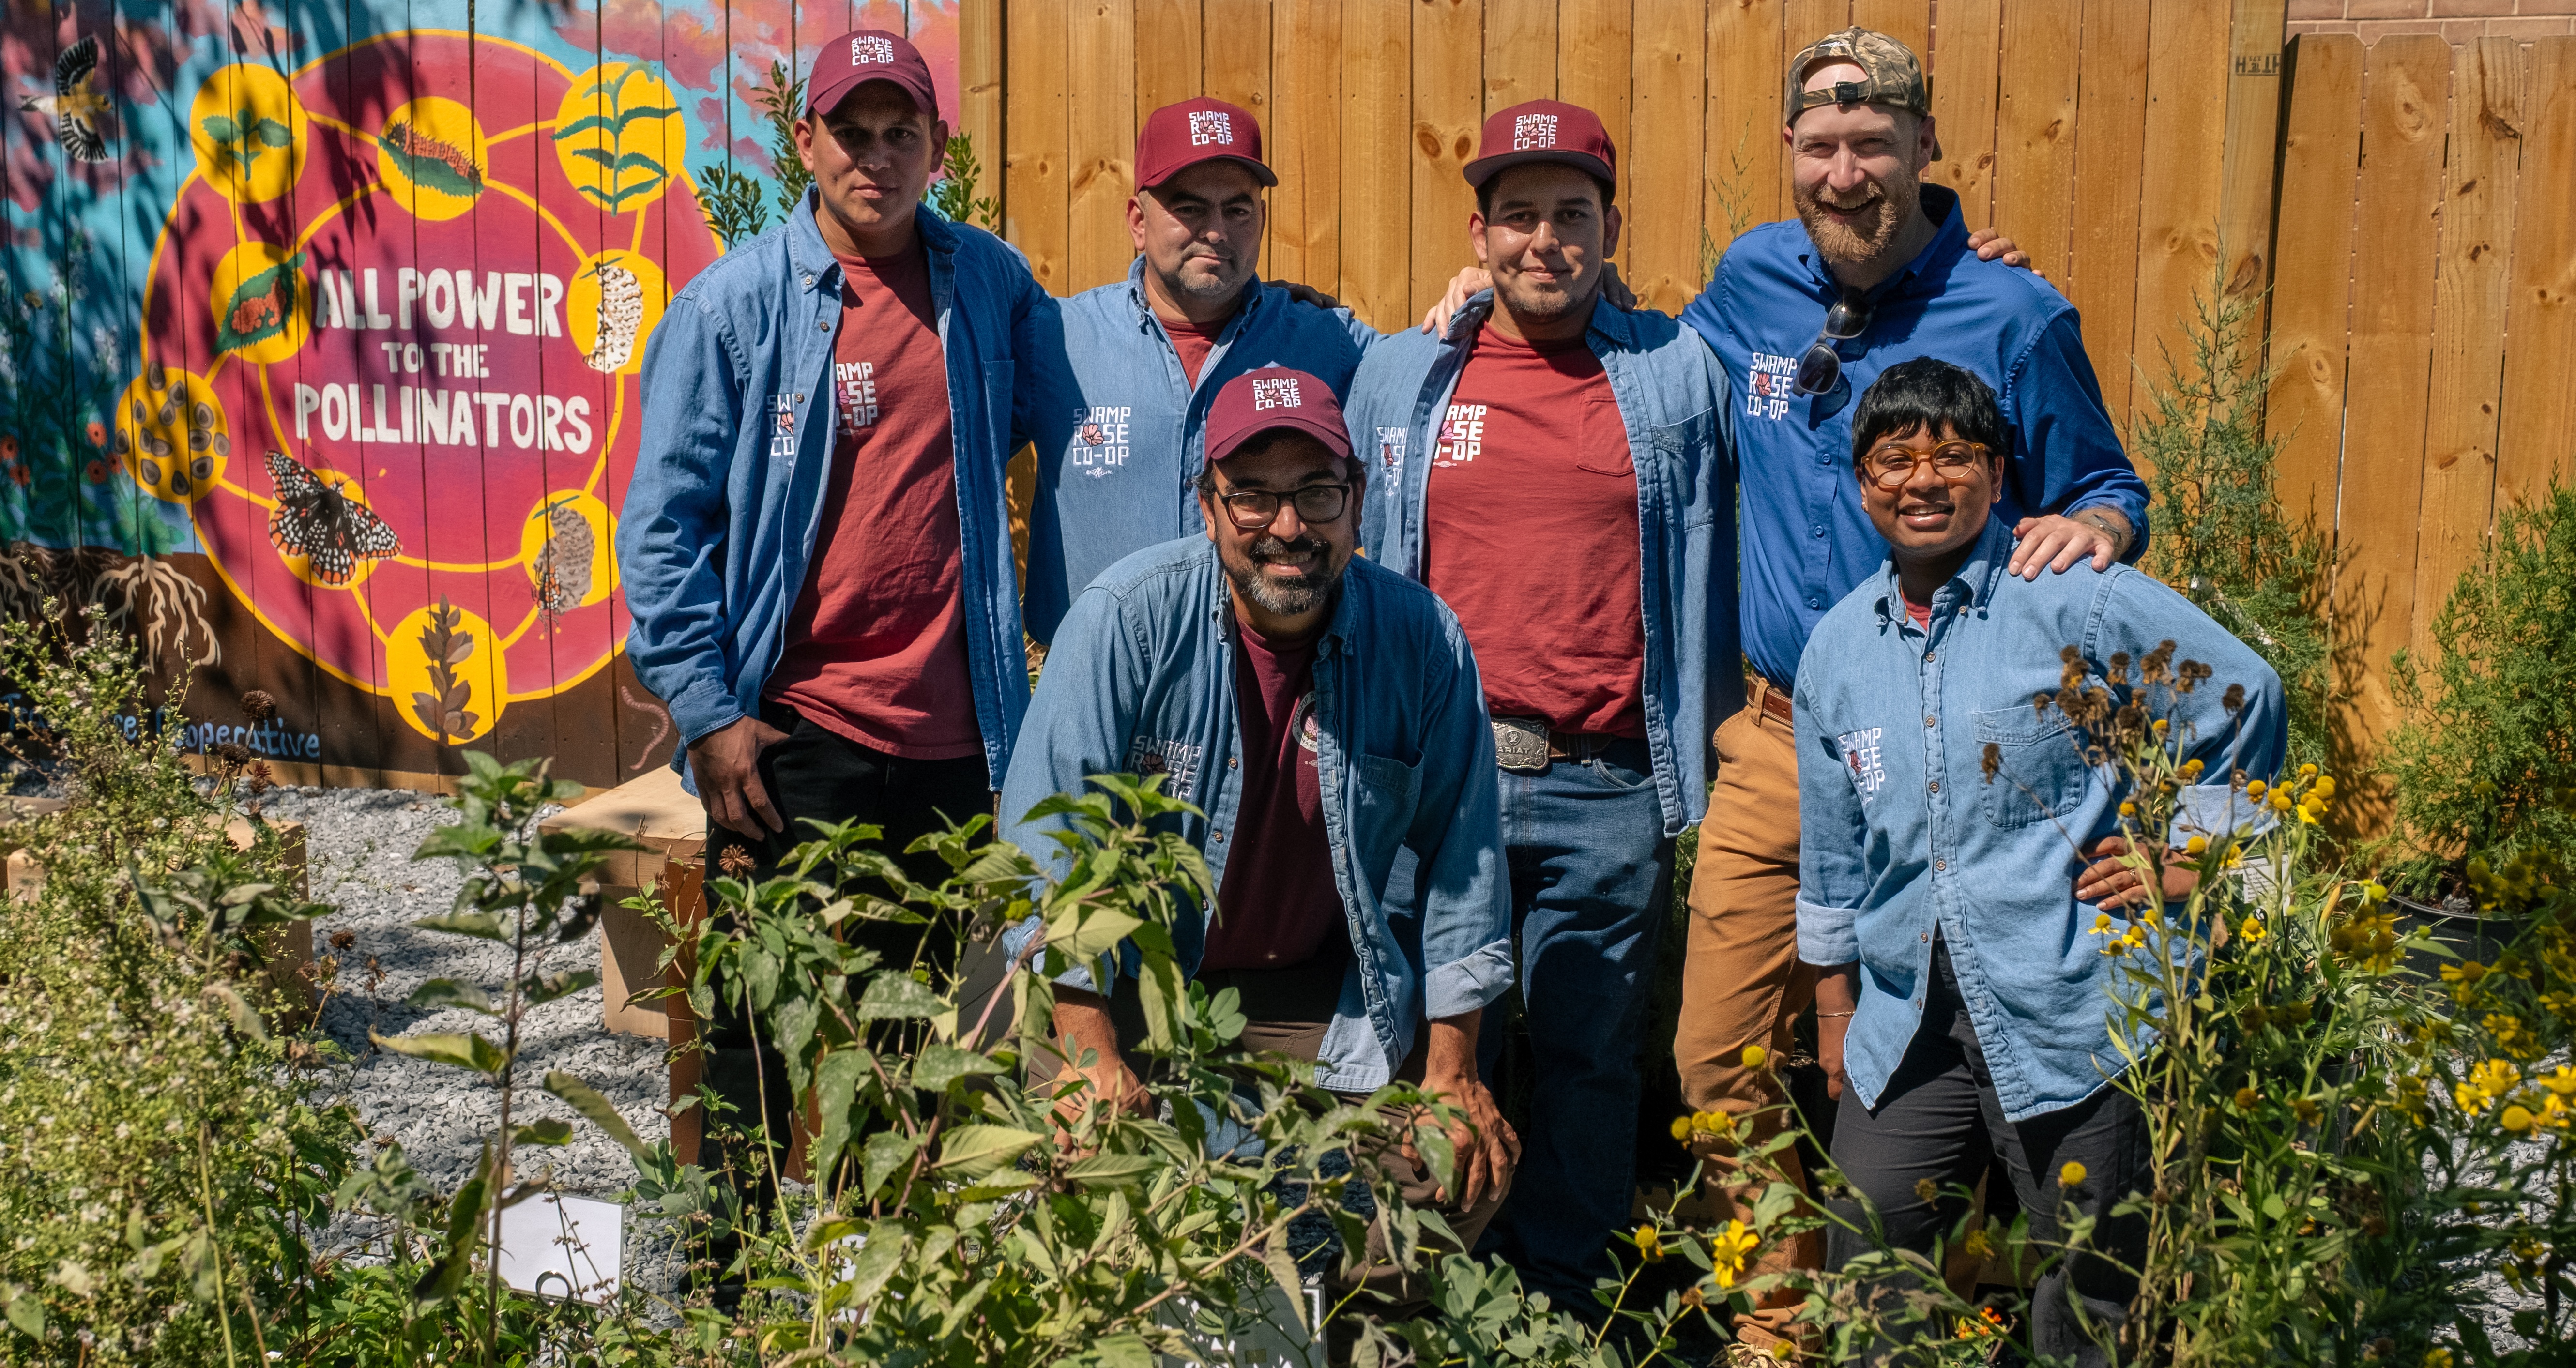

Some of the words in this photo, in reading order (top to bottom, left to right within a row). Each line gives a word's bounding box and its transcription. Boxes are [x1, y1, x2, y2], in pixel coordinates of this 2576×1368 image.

[851, 36, 892, 46] SWAMP
[852, 54, 894, 66] CO-OP
[1189, 111, 1229, 122] SWAMP
[1515, 114, 1558, 125] SWAMP
[1192, 133, 1233, 145] CO-OP
[1514, 137, 1555, 150] CO-OP
[316, 268, 392, 330] ALL
[398, 268, 564, 337] POWER
[382, 342, 424, 373] TO
[432, 343, 490, 378] THE
[1750, 352, 1797, 375] SWAMP
[836, 362, 873, 381] AMP
[1253, 378, 1298, 389] SWAMP
[1256, 398, 1301, 410] CO-OP
[1747, 395, 1789, 421] CO-OP
[294, 382, 593, 454] POLLINATORS
[1073, 406, 1130, 424] SWAMP
[1446, 405, 1487, 421] AMP
[1073, 446, 1129, 465] CO-OP
[1133, 736, 1202, 762] SWAMP
[1497, 746, 1531, 755] ARIAT
